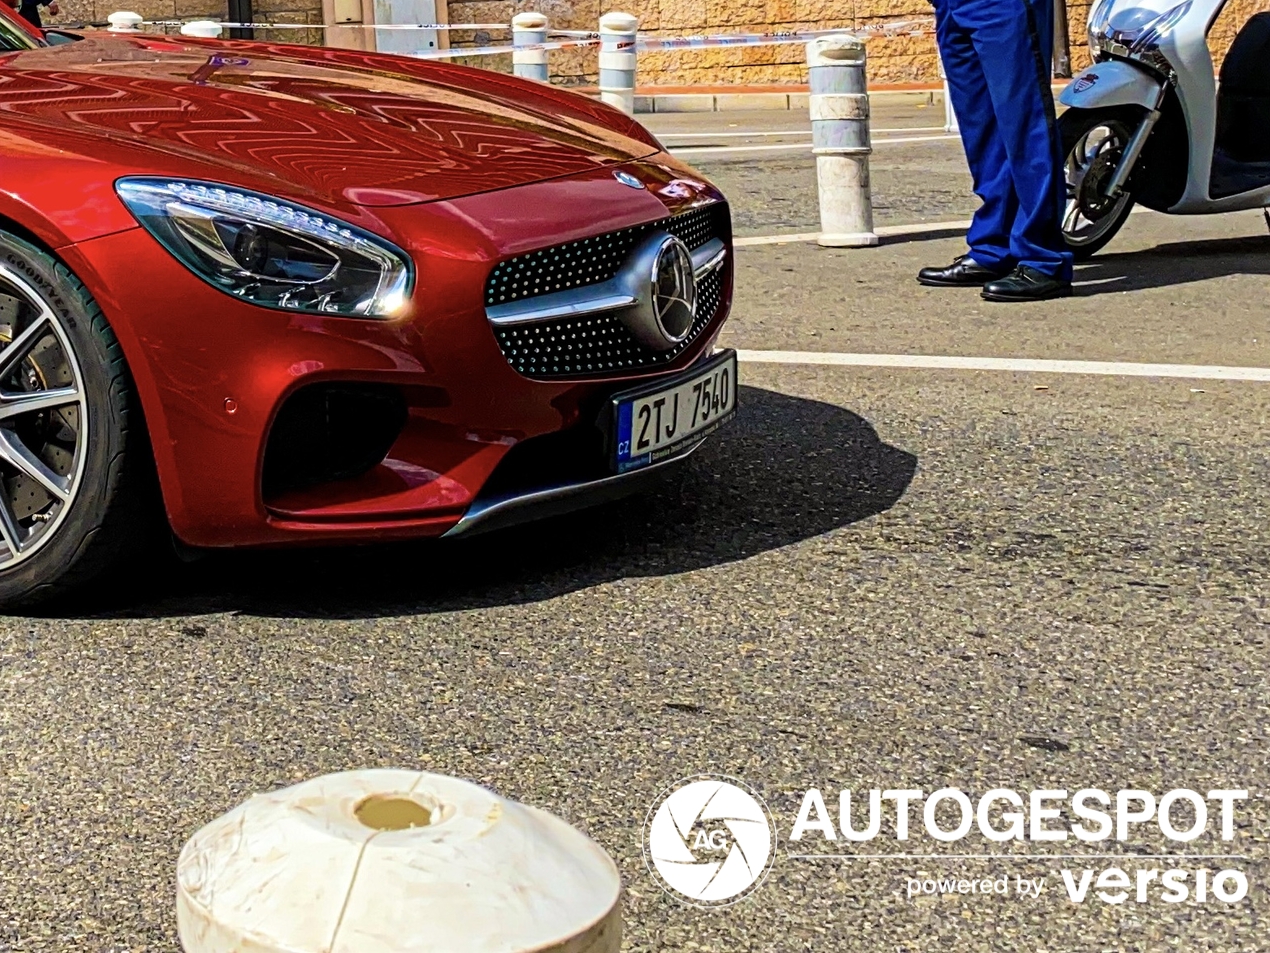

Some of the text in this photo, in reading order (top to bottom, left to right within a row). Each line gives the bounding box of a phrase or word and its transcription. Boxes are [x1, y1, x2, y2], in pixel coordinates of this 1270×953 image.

[7, 254, 77, 329] GOODYEAR
[637, 393, 679, 451] 2TJ
[691, 367, 728, 428] 7540
[618, 440, 629, 456] CZ
